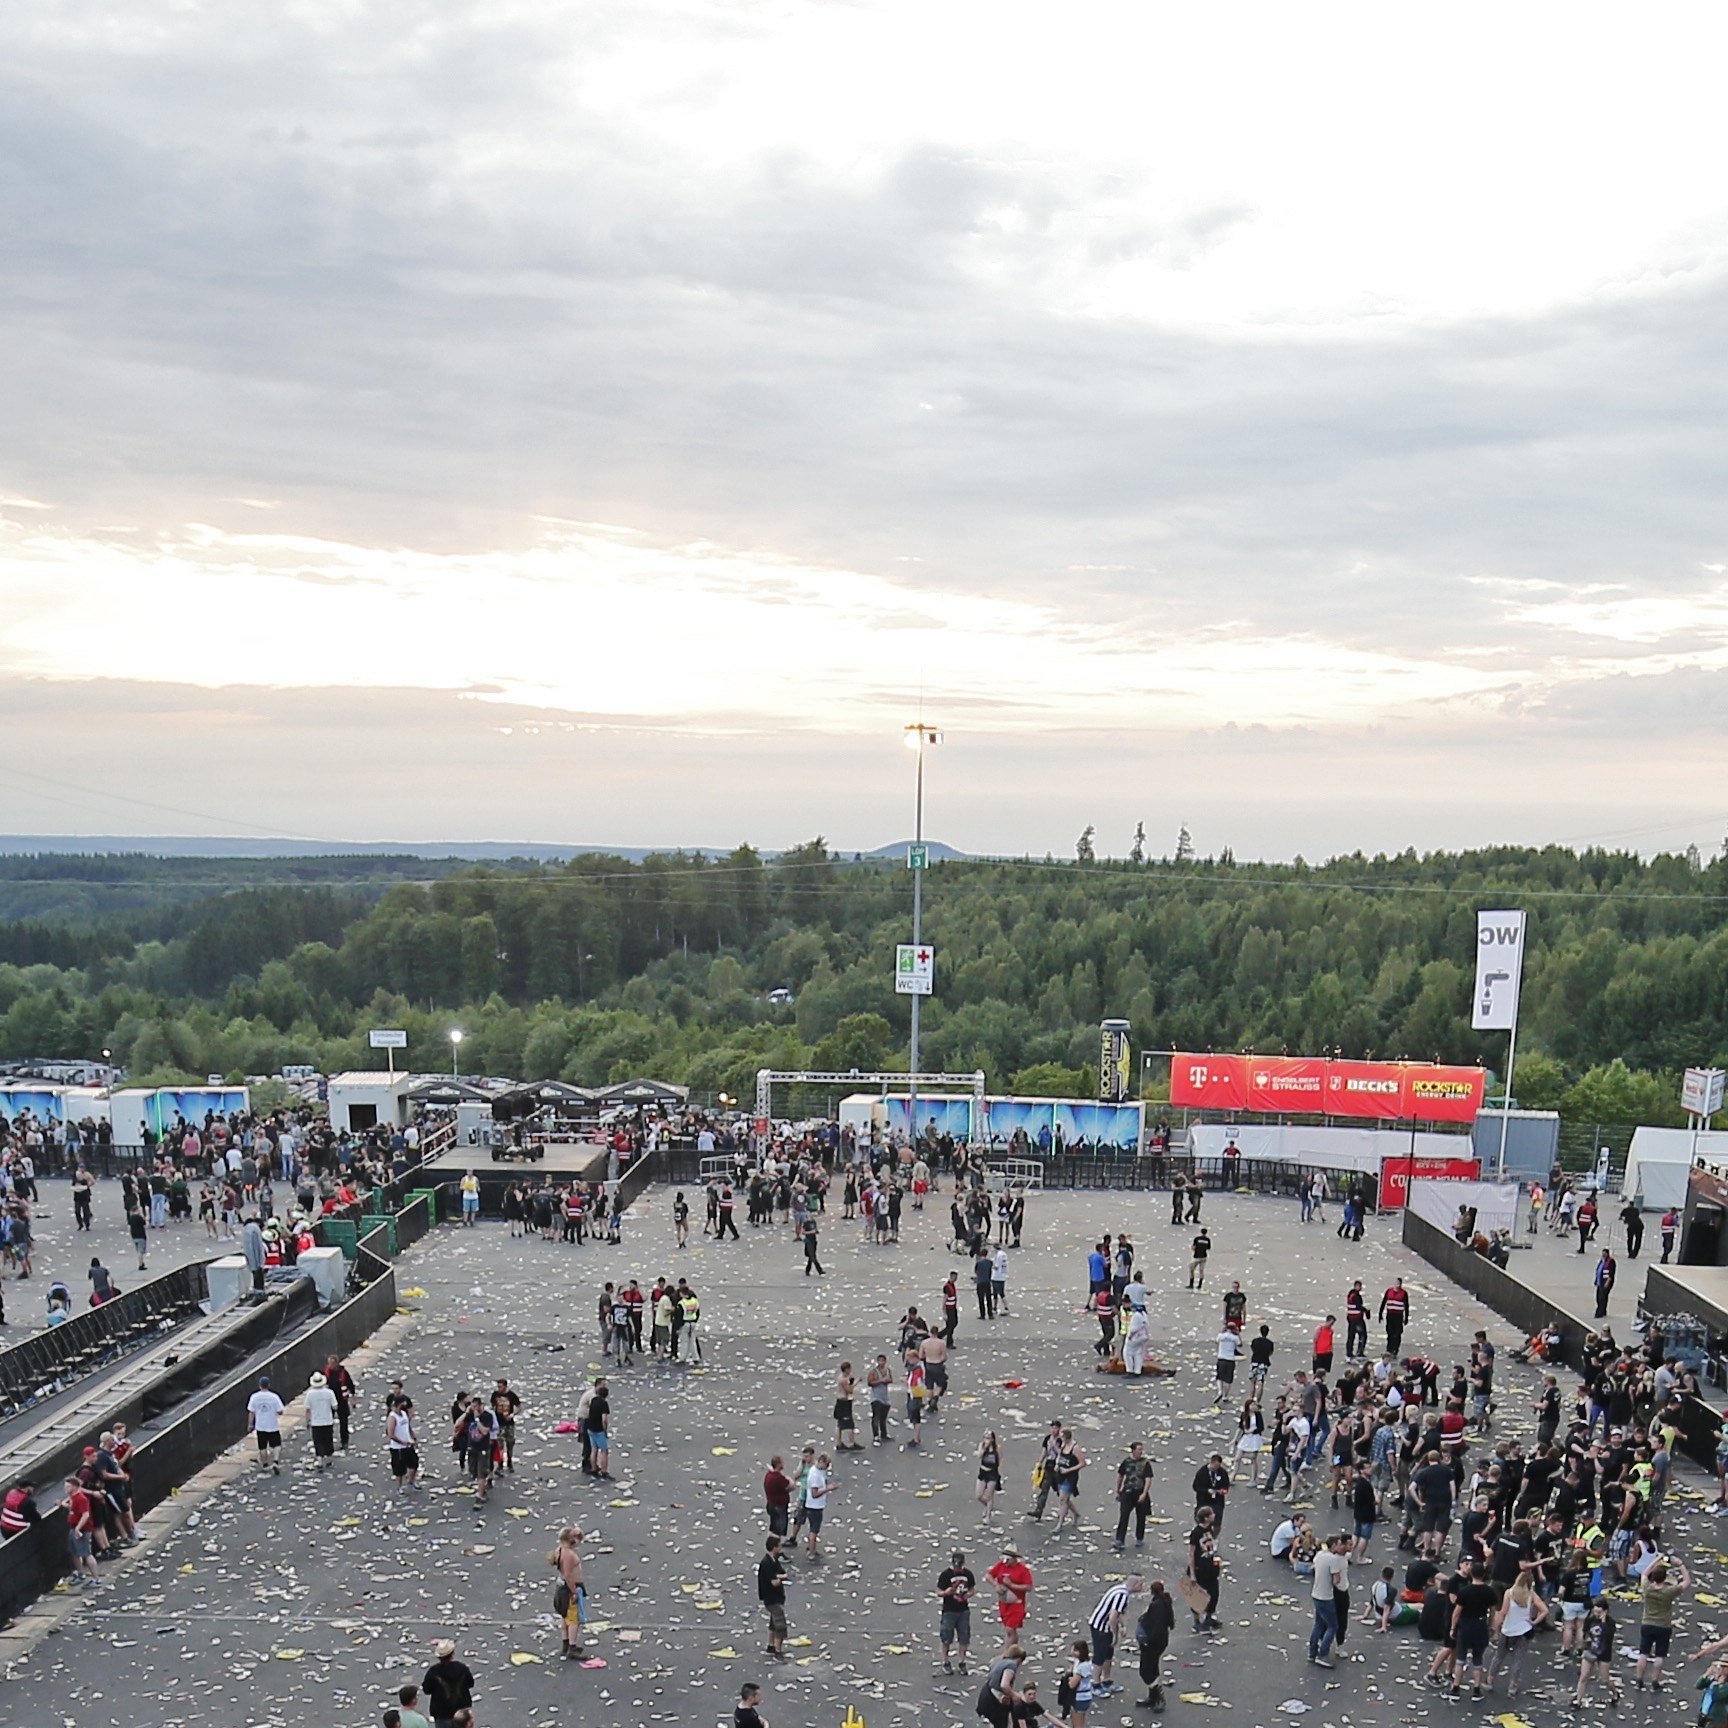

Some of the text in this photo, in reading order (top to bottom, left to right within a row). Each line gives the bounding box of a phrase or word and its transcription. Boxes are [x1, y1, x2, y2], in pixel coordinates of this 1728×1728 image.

[914, 856, 921, 866] 3
[897, 979, 914, 990] WC
[1100, 1030, 1113, 1098] ROCKSTAR
[1272, 1083, 1321, 1091] STRAUSS
[1346, 1080, 1399, 1093] BECK'S
[1412, 1080, 1472, 1095] ROCKSTAR
